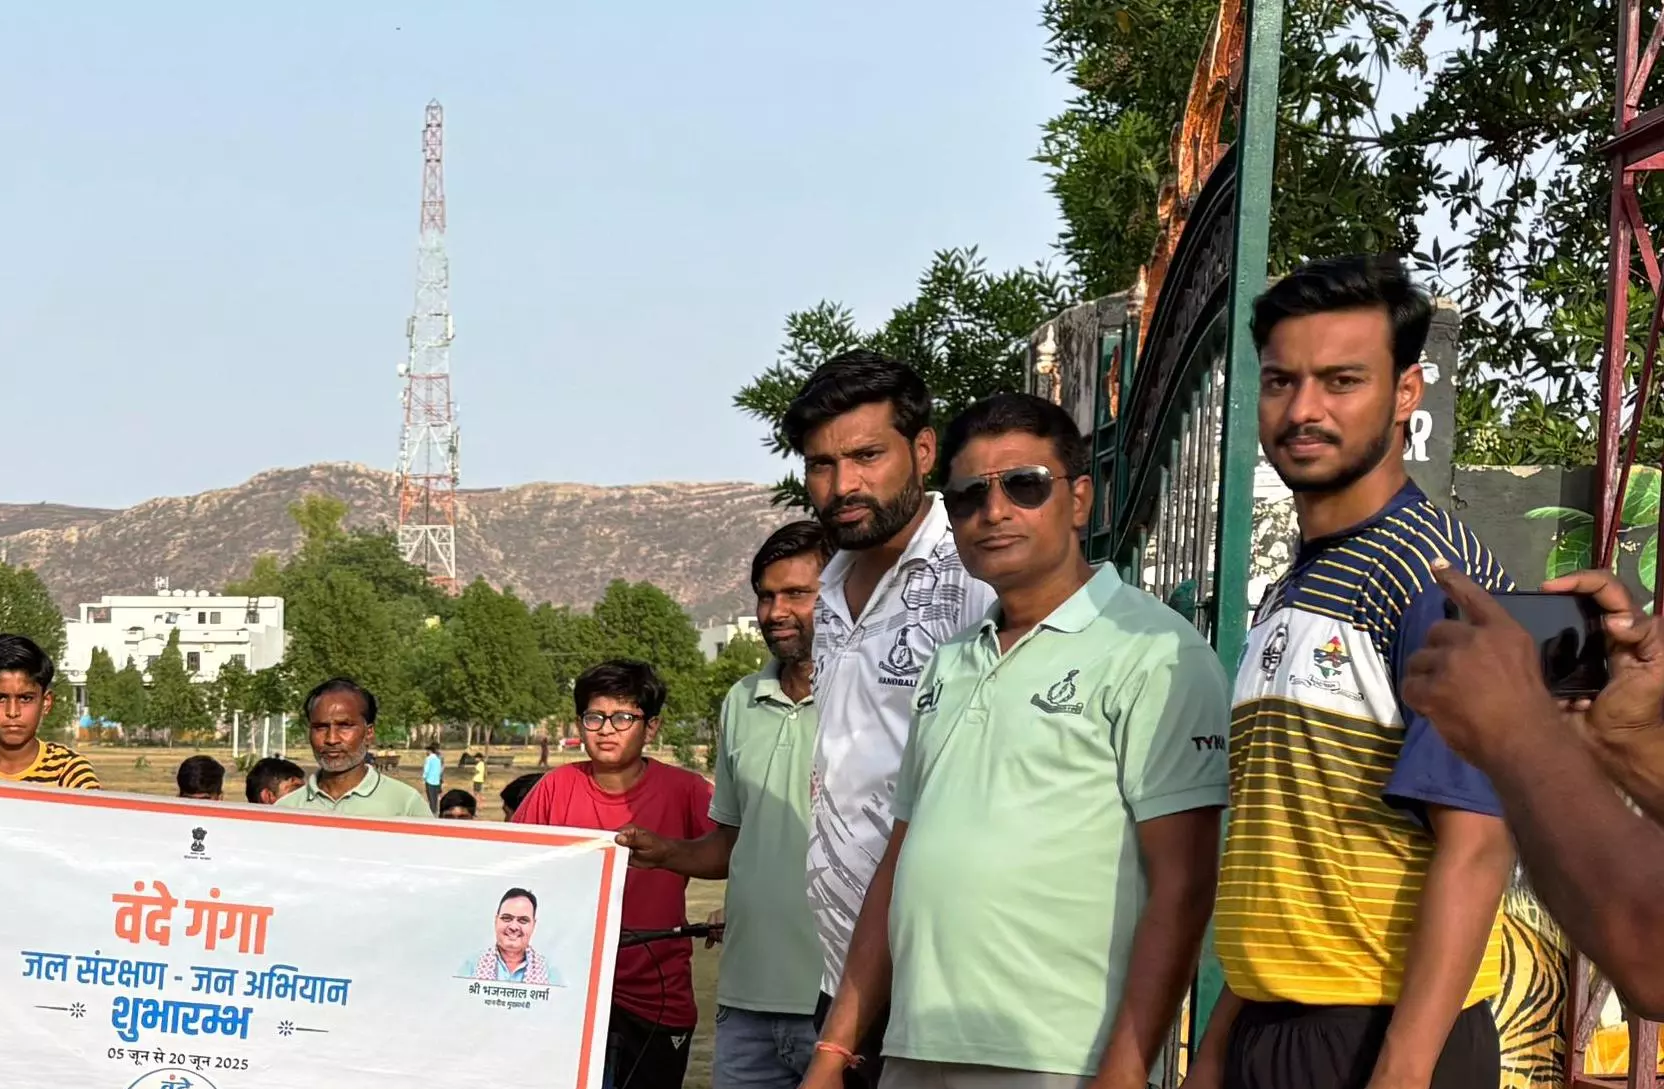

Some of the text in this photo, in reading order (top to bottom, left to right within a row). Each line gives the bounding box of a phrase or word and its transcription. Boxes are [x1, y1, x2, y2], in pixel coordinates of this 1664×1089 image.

[112, 880, 274, 954] वंदे गंगा
[21, 950, 71, 982] जल
[76, 950, 168, 990] संरक्षण
[190, 966, 238, 997] जन
[243, 964, 352, 1006] अभियान
[468, 982, 550, 1001] श्री भजनलाल शर्मा
[111, 995, 253, 1042] शुभारम्भ
[107, 1047, 249, 1071] 05 जून से 20 जून 2025
